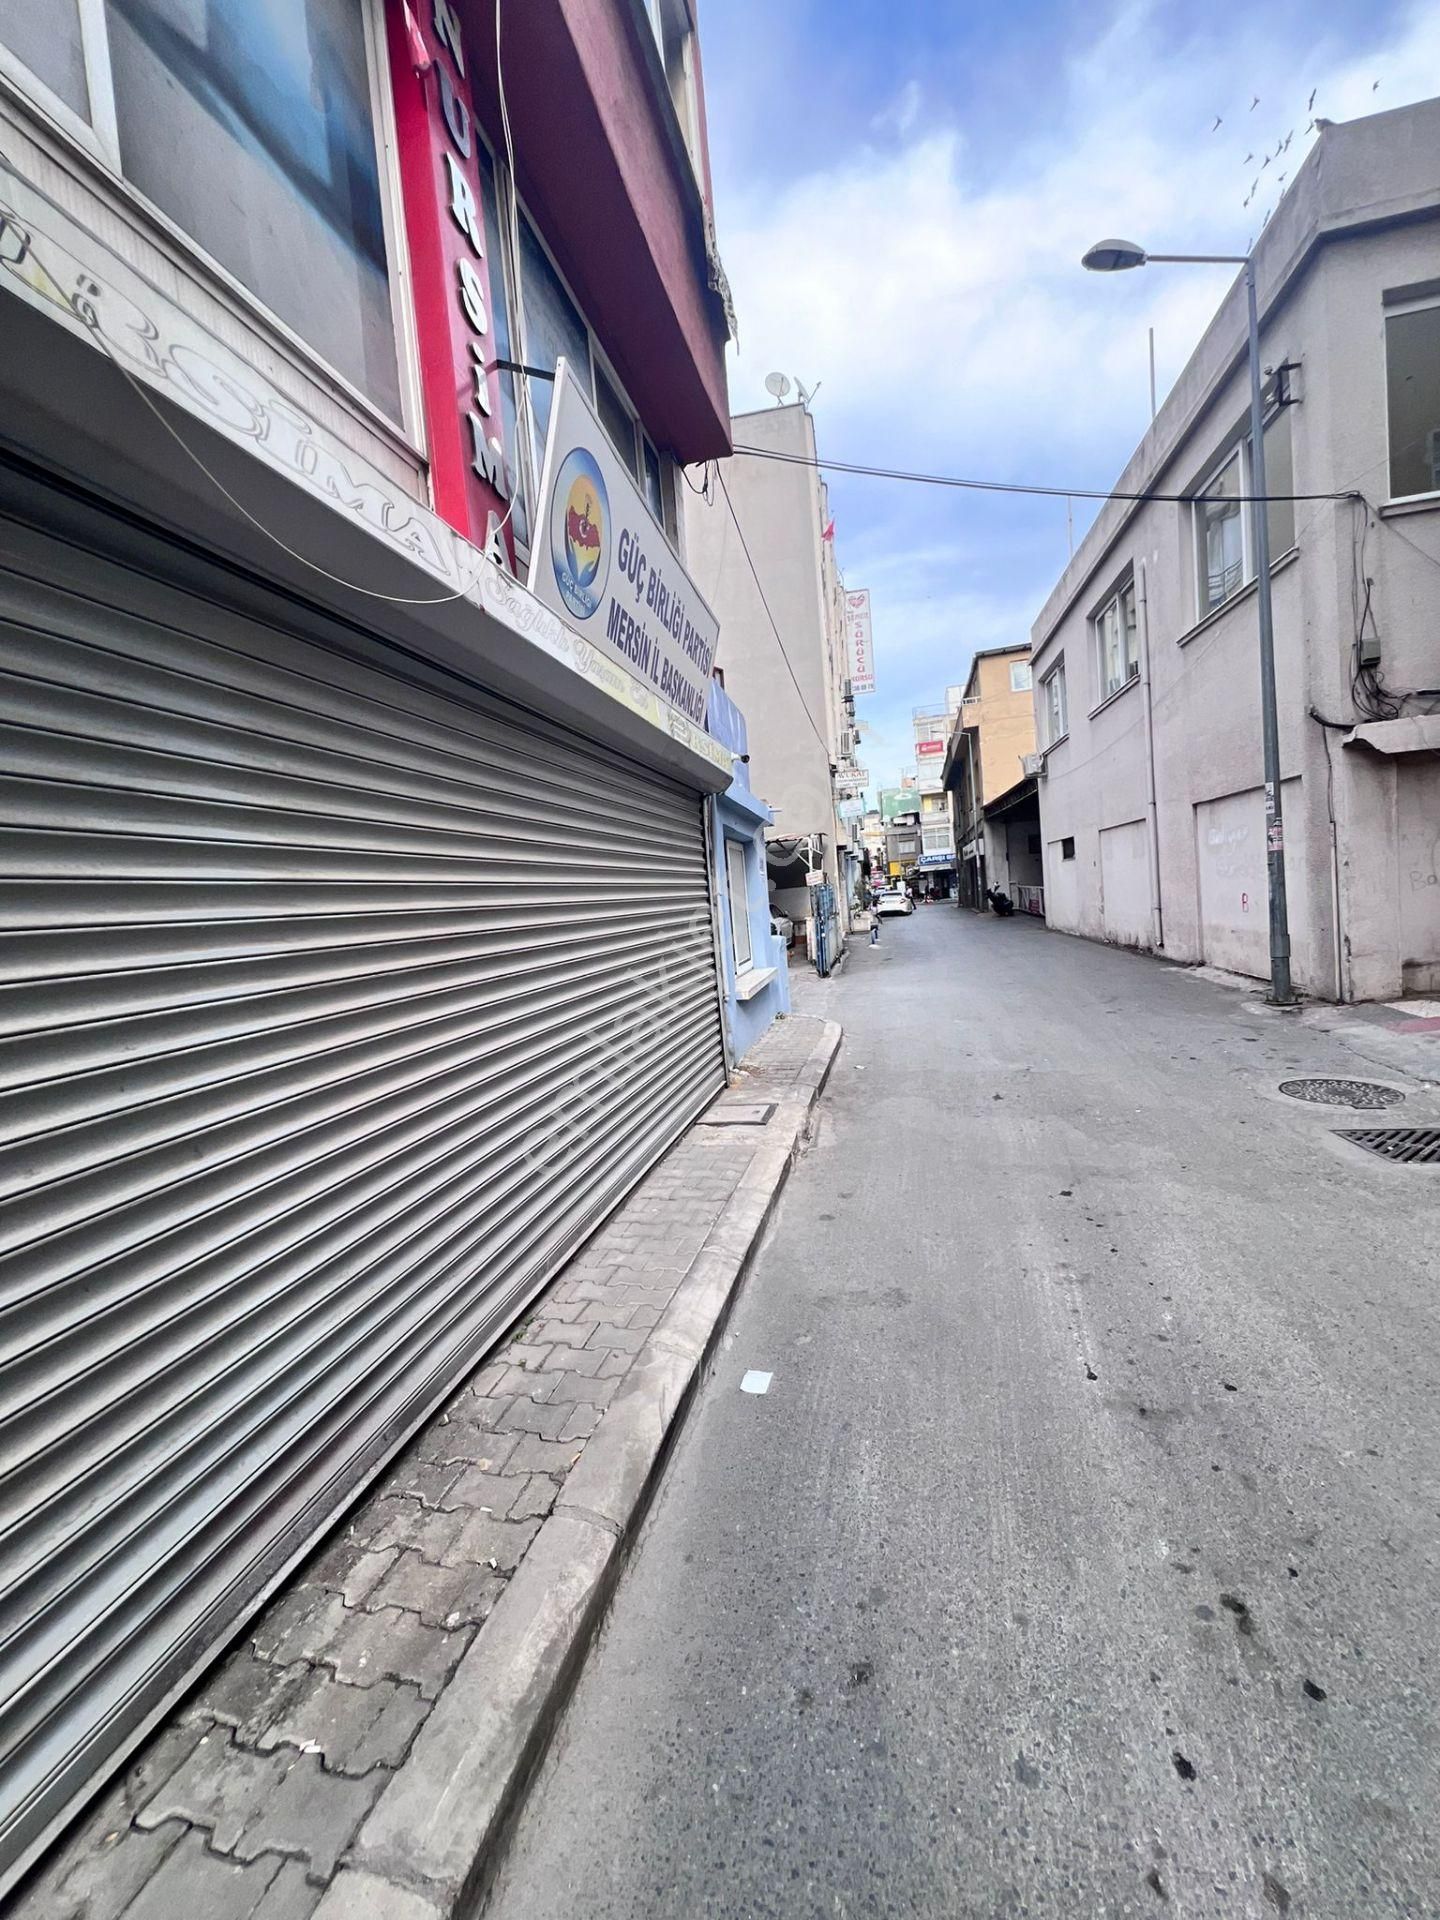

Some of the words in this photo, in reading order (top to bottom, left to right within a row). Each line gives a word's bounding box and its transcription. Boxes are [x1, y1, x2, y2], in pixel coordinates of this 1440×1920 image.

[606, 597, 652, 675] MERSİN
[650, 637, 661, 685] İL
[659, 656, 705, 726] BAŞKANLIĞI
[618, 528, 647, 603] GÜÇ
[646, 567, 686, 645] BİRLİĞİ
[681, 619, 714, 679] PARTİSİ
